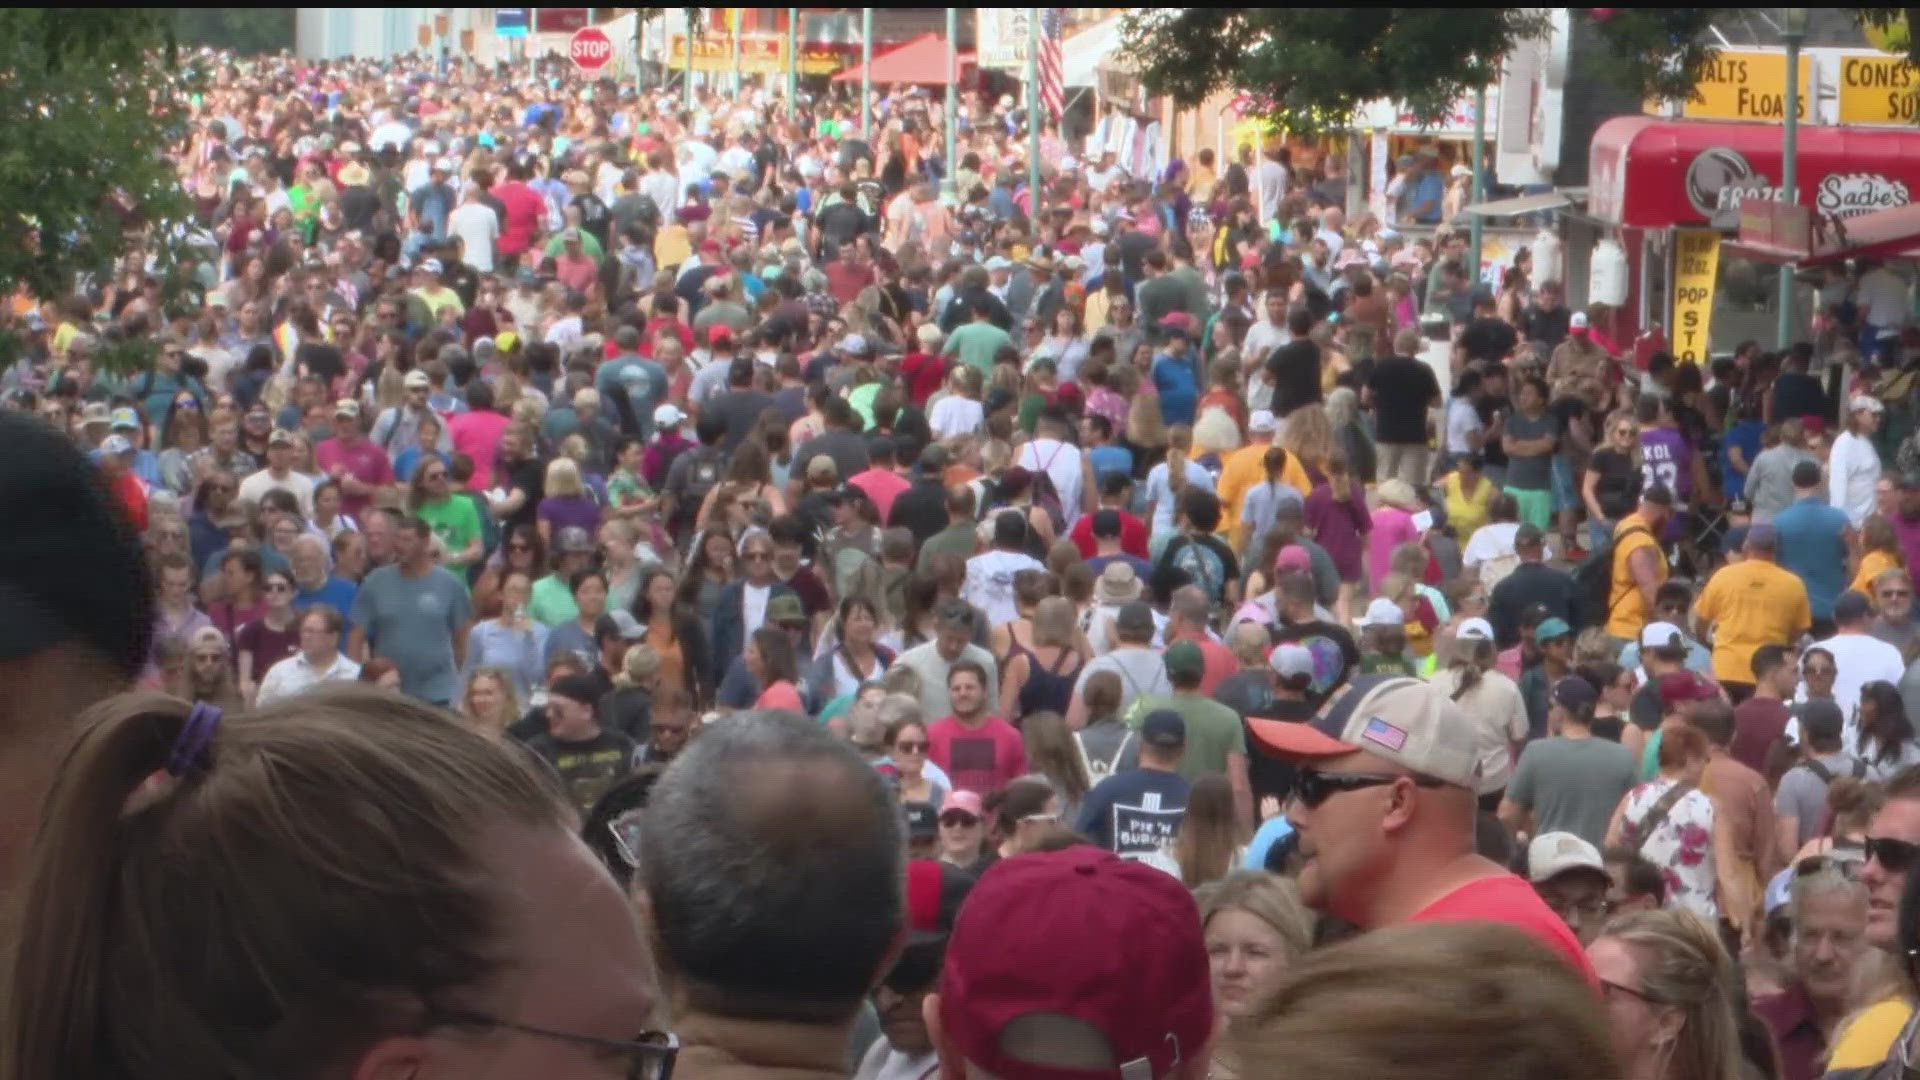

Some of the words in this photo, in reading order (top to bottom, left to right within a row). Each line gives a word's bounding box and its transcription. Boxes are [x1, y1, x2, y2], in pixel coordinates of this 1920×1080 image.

[572, 41, 610, 57] STOP
[1846, 59, 1910, 88] CONES
[1738, 88, 1805, 119] FLOAS
[1888, 92, 1920, 120] SU
[1819, 175, 1908, 209] Sadie's
[1678, 287, 1709, 305] POP
